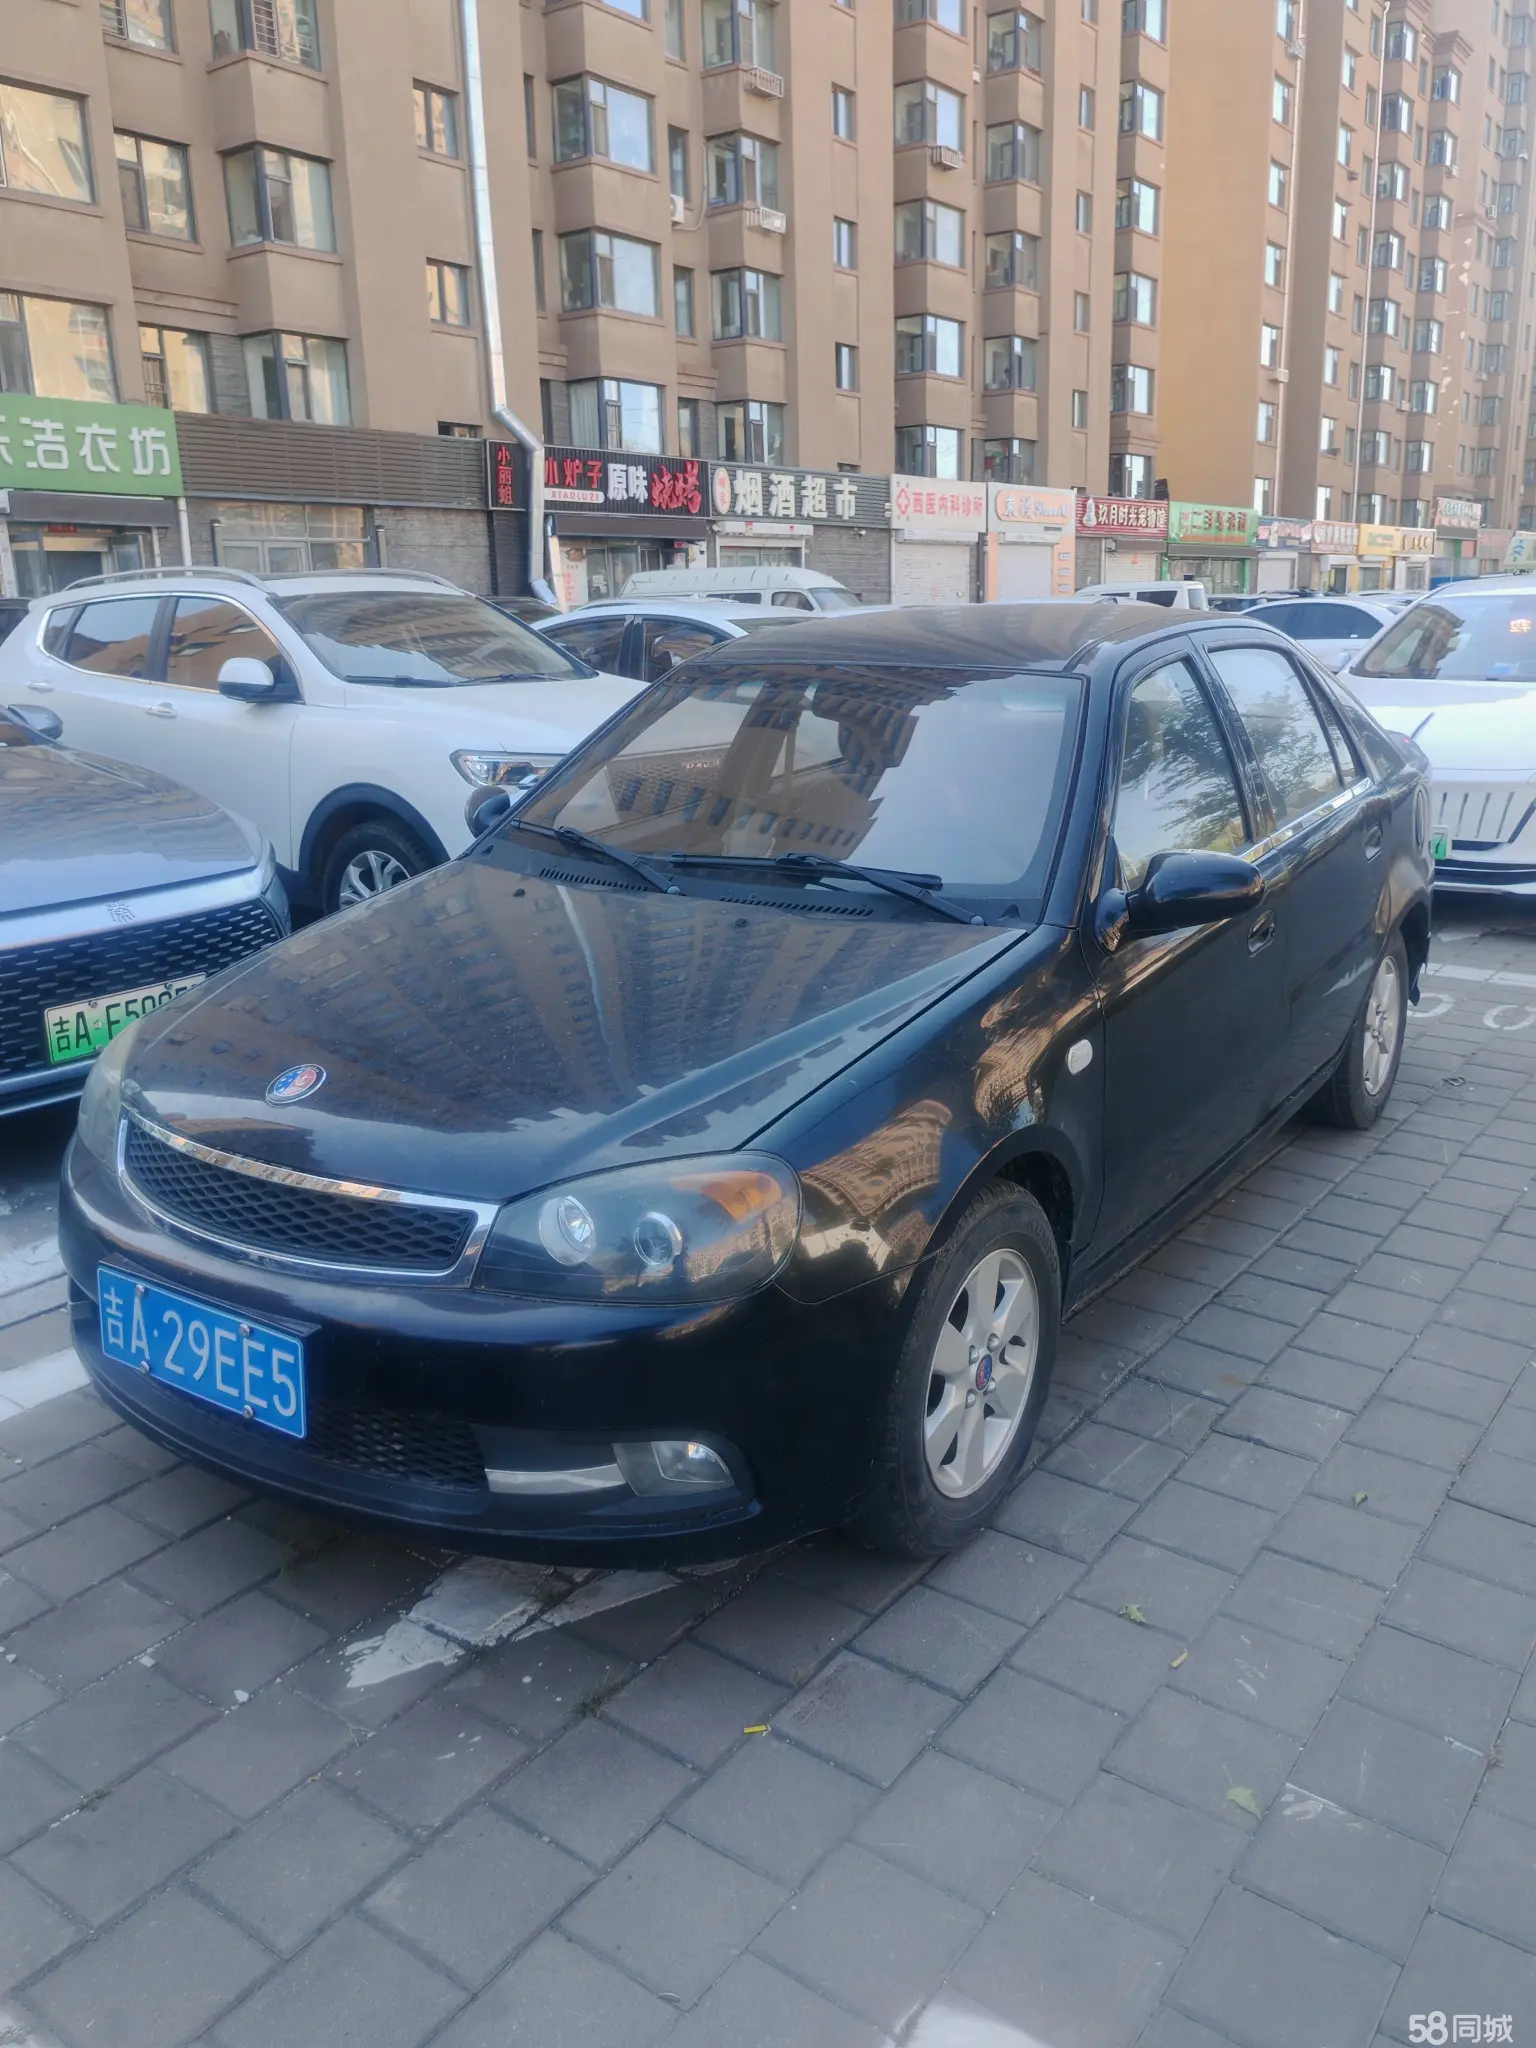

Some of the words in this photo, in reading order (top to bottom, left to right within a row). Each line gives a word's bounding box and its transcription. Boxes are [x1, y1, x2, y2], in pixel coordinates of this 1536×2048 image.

[497, 445, 513, 505] 小丽姐
[545, 457, 603, 489] 小炉子
[607, 463, 648, 504] 原味
[651, 460, 702, 515] 烧烤
[733, 469, 859, 520] 烟酒超市
[912, 492, 983, 517] 西医内科诊所
[1098, 504, 1166, 528] 玖月时光宠物馆
